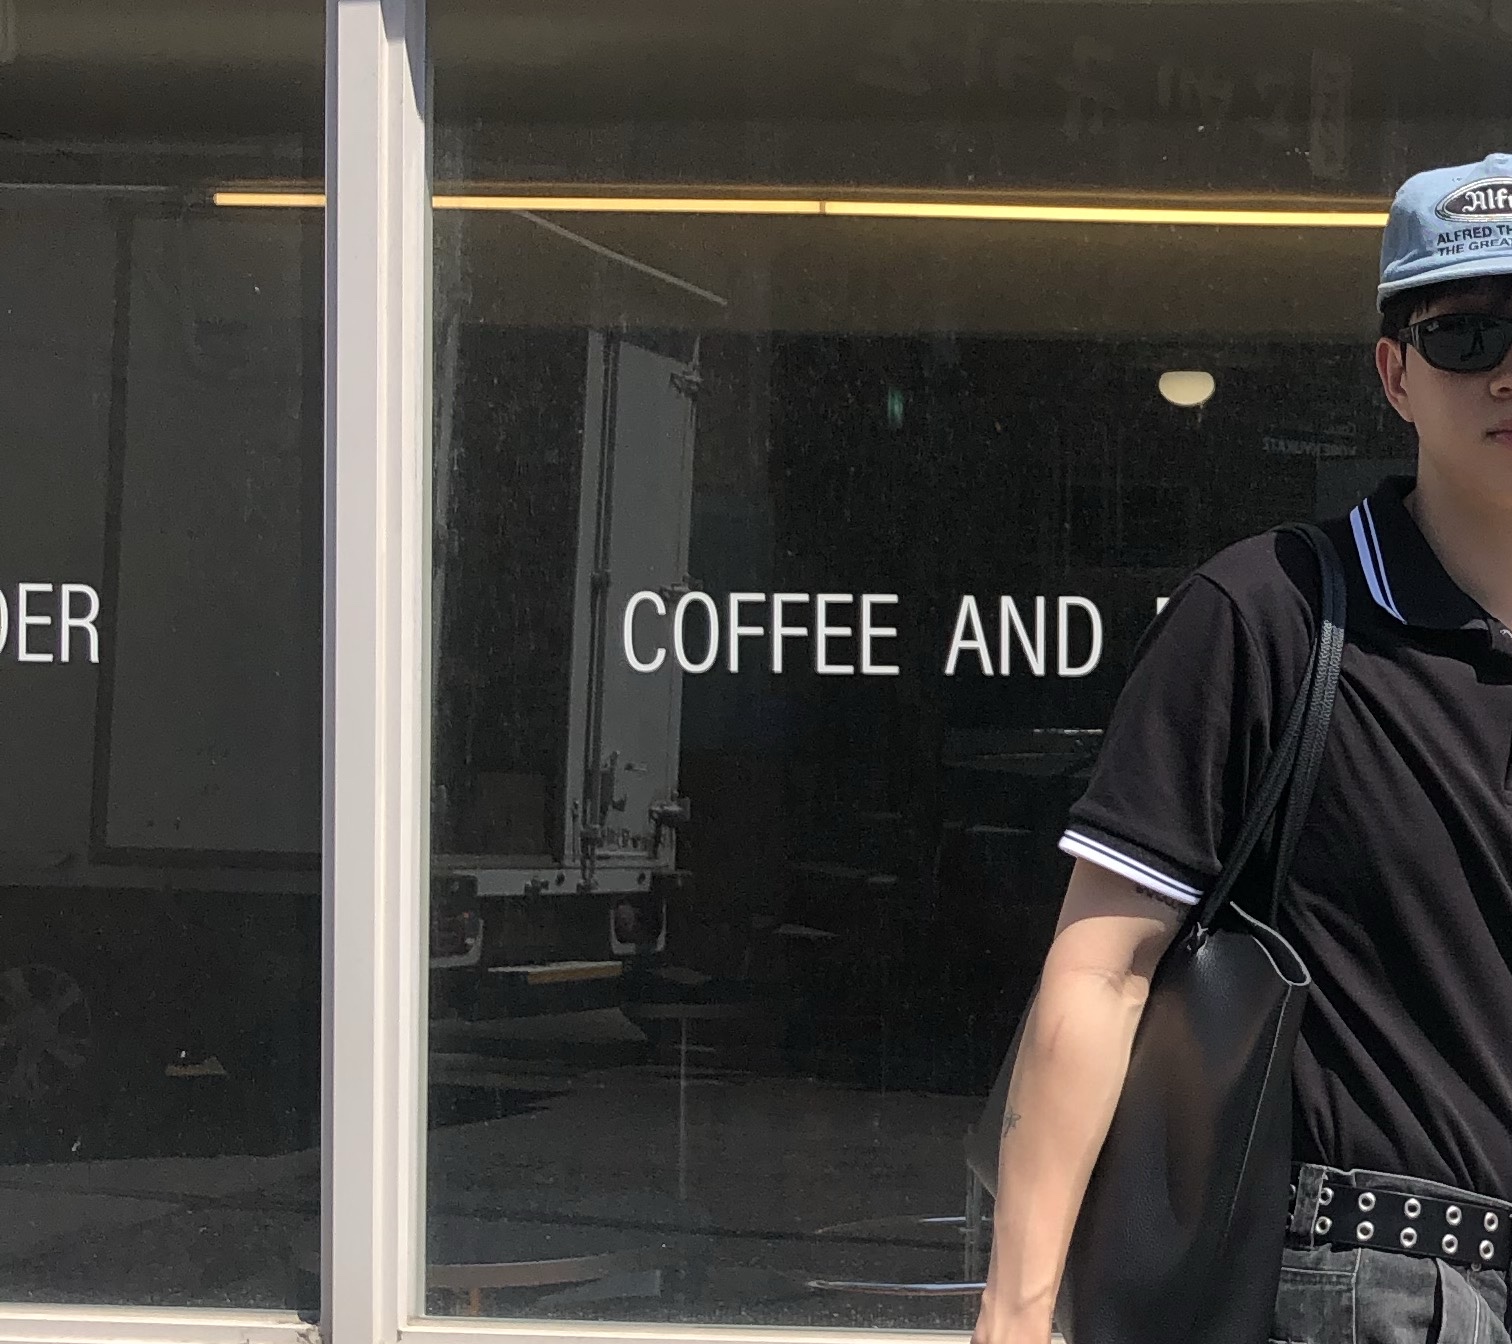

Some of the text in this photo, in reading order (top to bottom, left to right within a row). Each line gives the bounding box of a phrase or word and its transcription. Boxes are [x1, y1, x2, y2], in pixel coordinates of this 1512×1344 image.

[1436, 225, 1493, 246] ALFRED
[1437, 243, 1464, 256] THE
[0, 583, 100, 663] ER
[623, 590, 1103, 677] COFFEE AND
